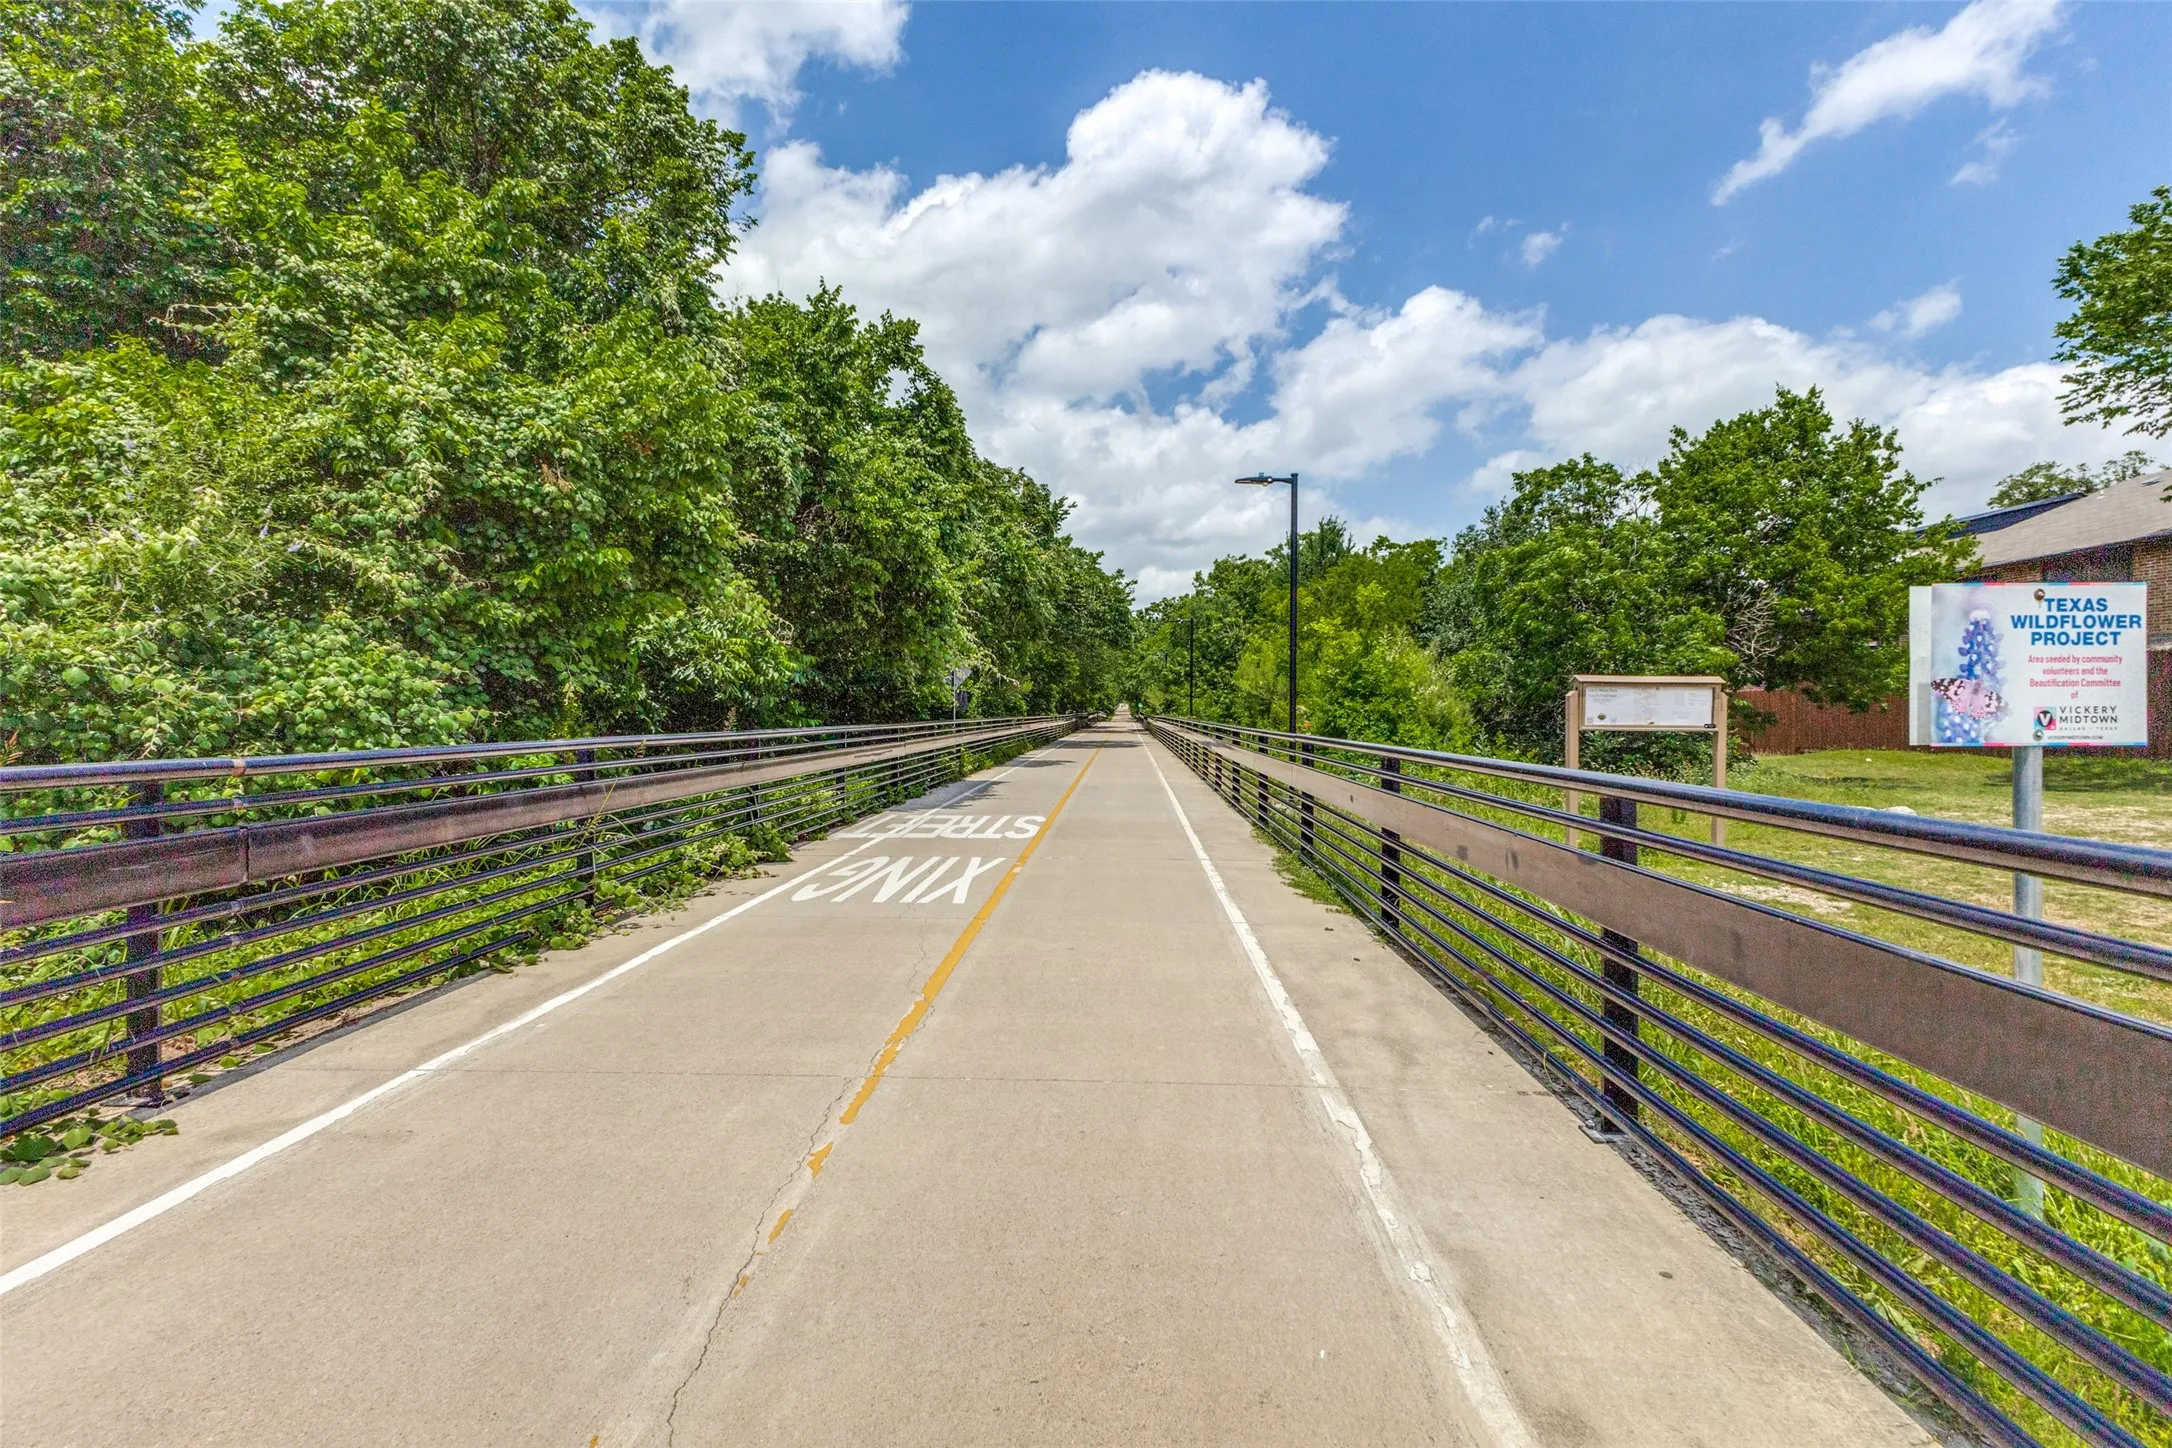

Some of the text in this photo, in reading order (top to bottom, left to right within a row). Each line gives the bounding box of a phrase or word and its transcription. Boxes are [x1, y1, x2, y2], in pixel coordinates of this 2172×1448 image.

[2044, 598, 2108, 612] TEXAS
[2011, 615, 2142, 629] WILDFLOWER
[2031, 632, 2121, 646] PROJECT
[2028, 654, 2123, 664] Area seeded by community
[2042, 667, 2108, 675] volunteers and the
[2029, 678, 2121, 687] Beautification Committee
[2070, 691, 2079, 699] of
[2059, 706, 2117, 714] VICKERY
[2039, 712, 2052, 726] V
[2059, 716, 2118, 724] MIDTOWN
[831, 814, 1047, 839] STREET
[791, 856, 1008, 904] XING
